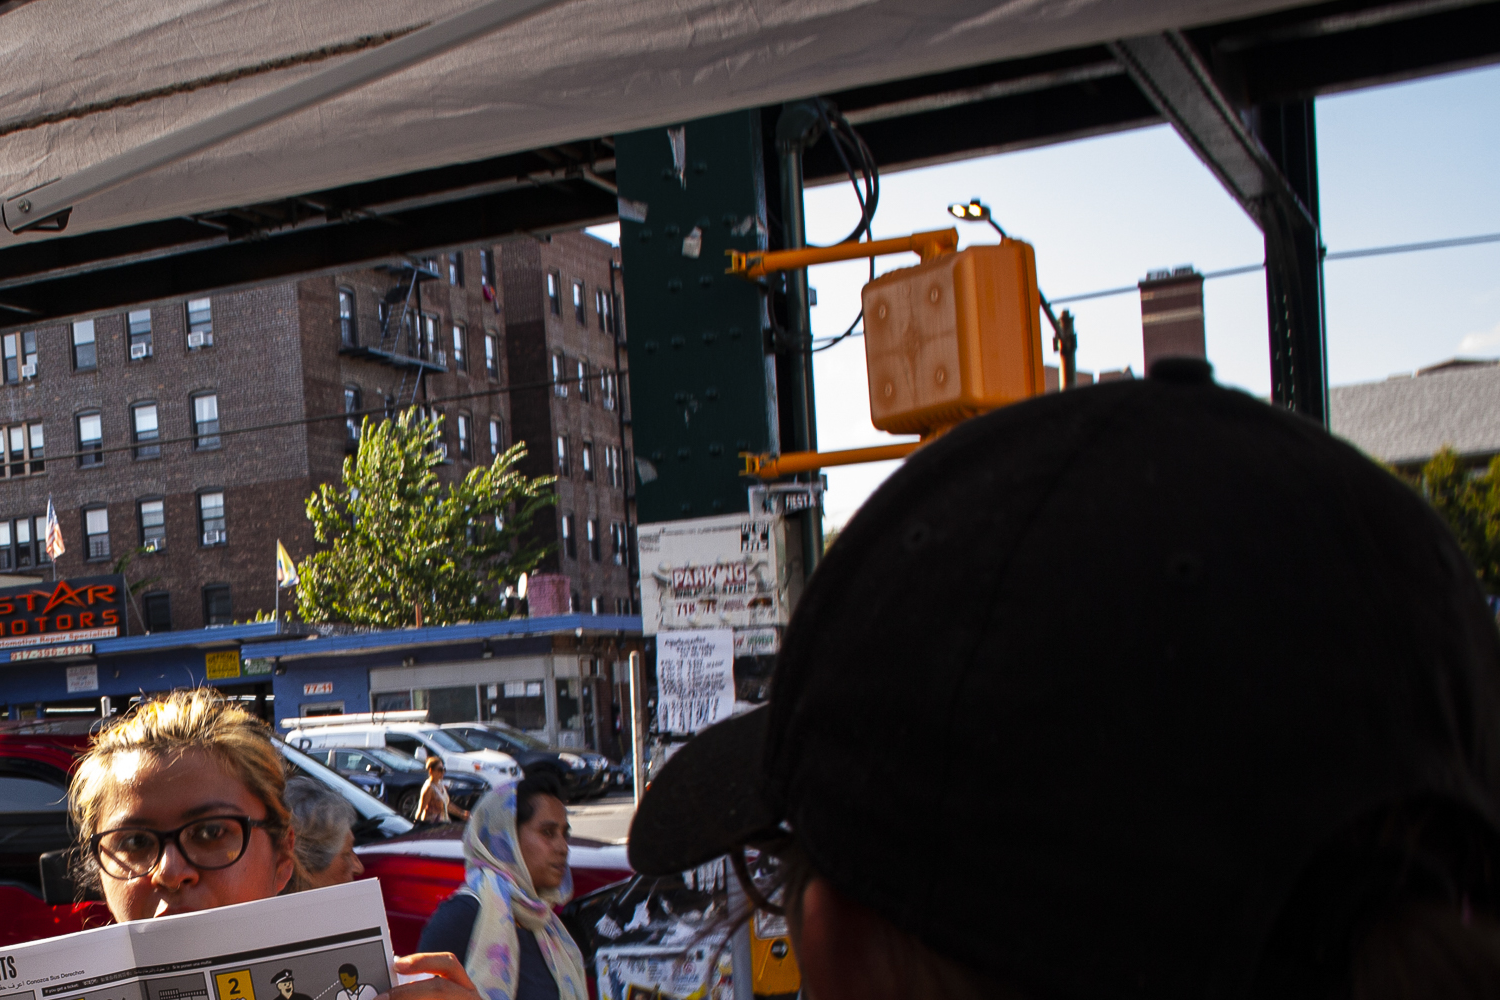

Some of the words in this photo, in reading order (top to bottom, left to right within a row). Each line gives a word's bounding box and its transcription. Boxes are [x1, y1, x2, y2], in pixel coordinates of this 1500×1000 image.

[39, 634, 66, 645] Repair
[69, 629, 116, 643] Specialists
[26, 977, 50, 986] Conozca
[61, 969, 85, 979] Derechos
[228, 978, 241, 995] 2
